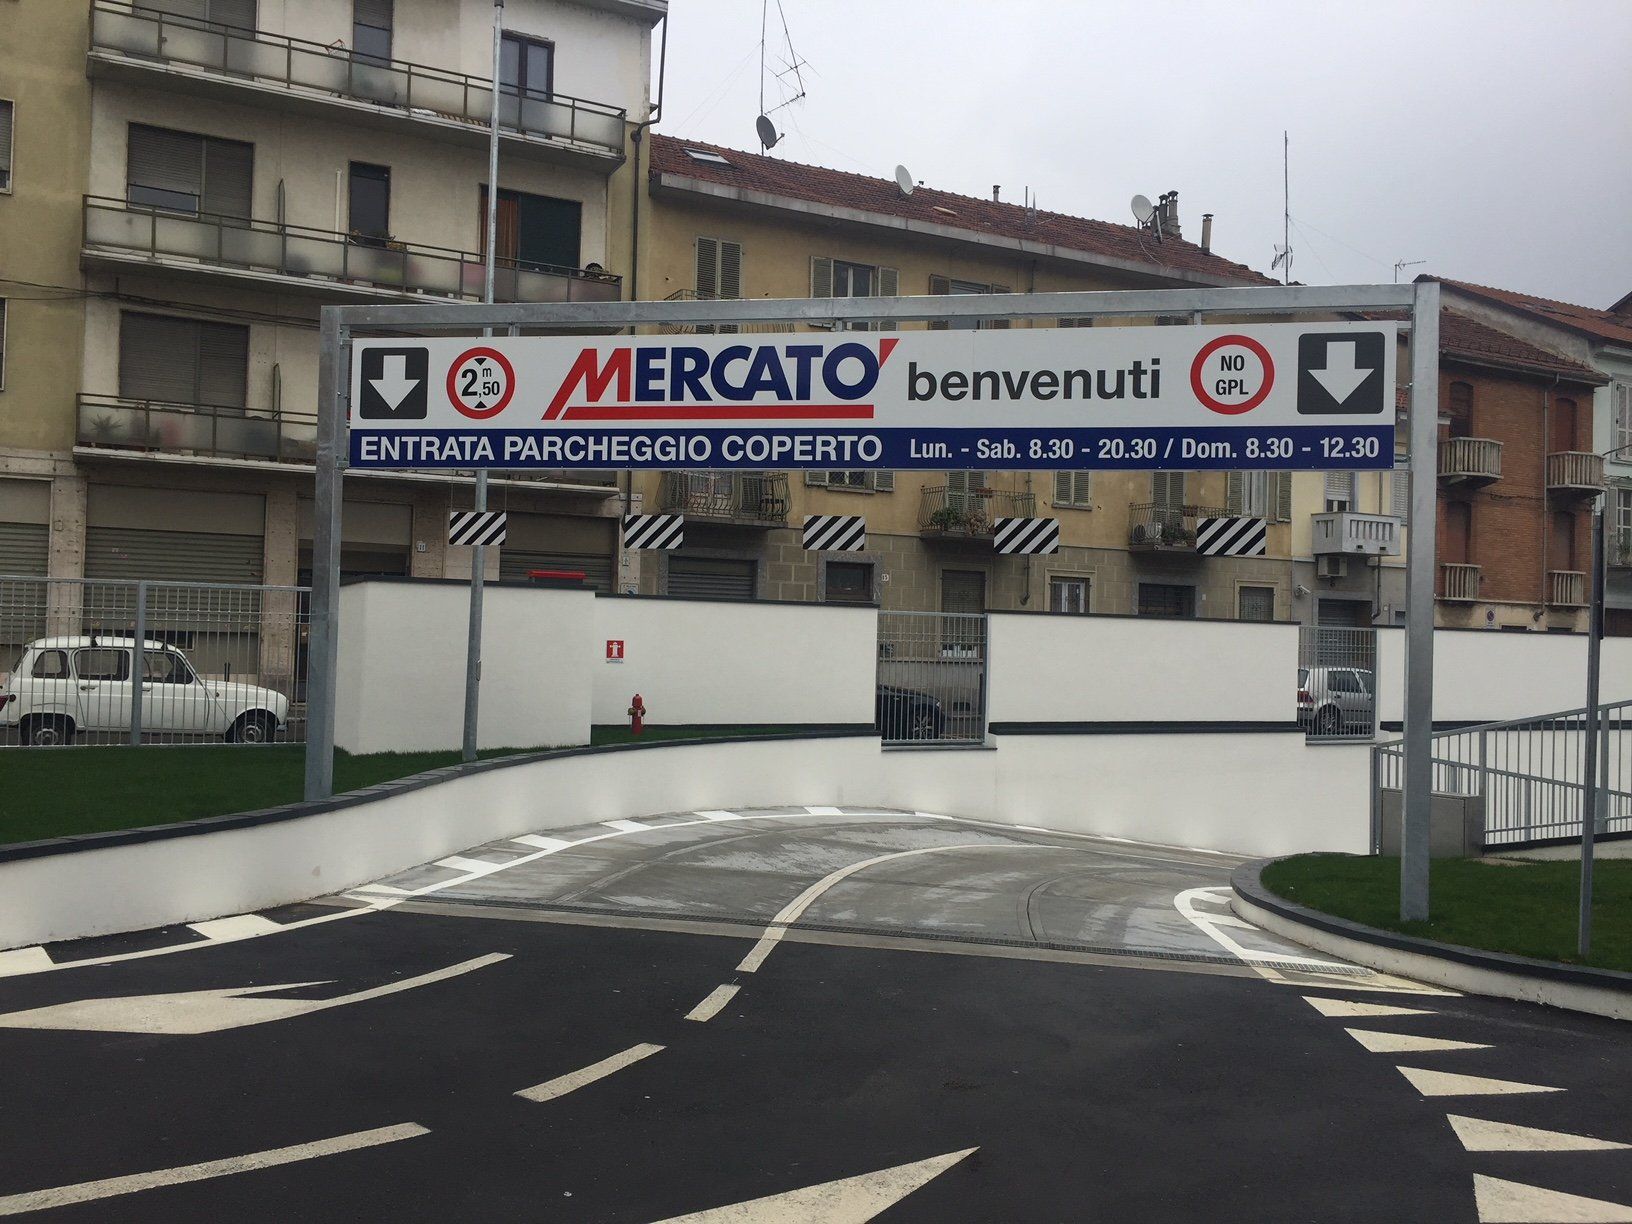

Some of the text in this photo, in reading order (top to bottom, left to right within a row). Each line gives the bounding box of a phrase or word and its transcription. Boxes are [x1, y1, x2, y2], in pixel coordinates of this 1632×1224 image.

[1220, 355, 1245, 371] NO
[907, 357, 1161, 401] benvenuti
[1215, 379, 1249, 395] GPL
[360, 434, 883, 462] ENTRATA PARCHEGGIO COPERTO
[910, 438, 953, 459] Lun.
[976, 438, 1021, 459] Sab.
[1029, 438, 1074, 459] 8.30
[1098, 438, 1157, 459] 20.30
[1181, 438, 1237, 459] Dom.
[1245, 437, 1294, 459] 8.30
[1319, 436, 1380, 458] 12.30
